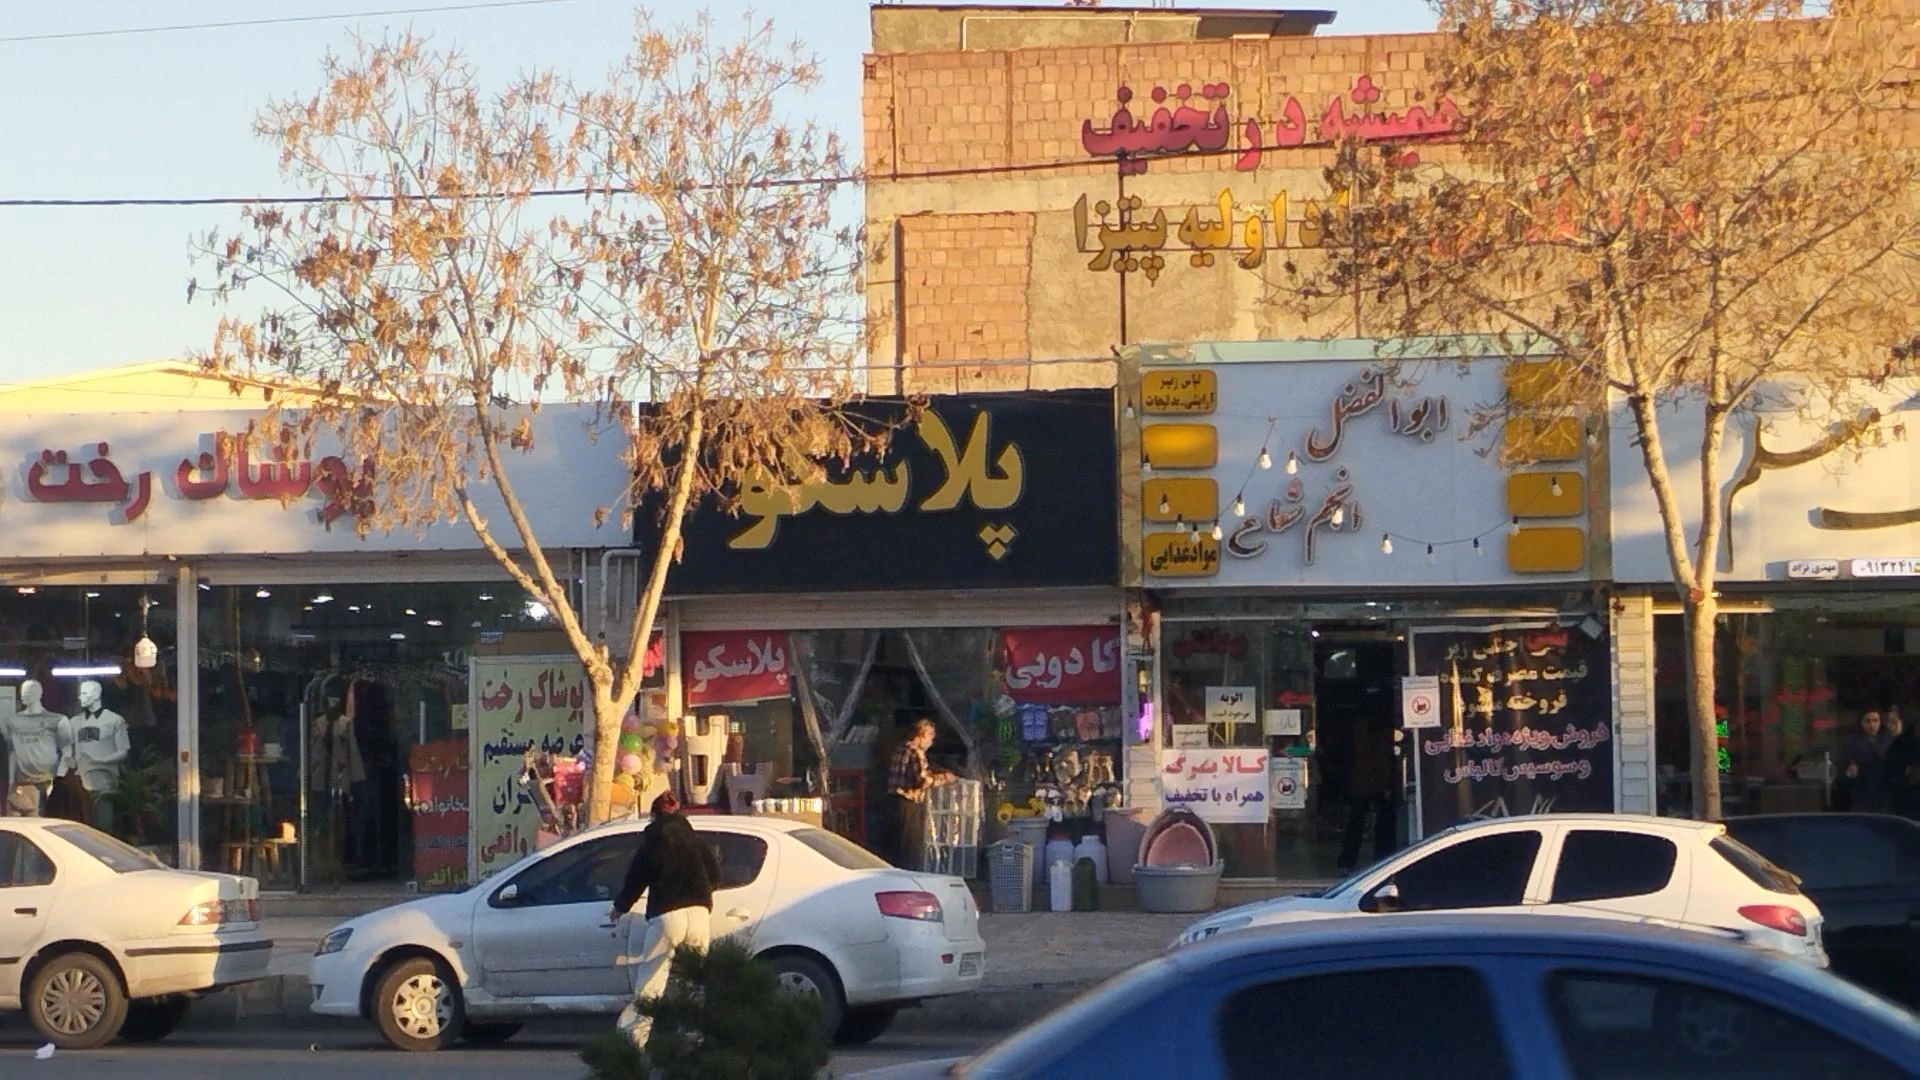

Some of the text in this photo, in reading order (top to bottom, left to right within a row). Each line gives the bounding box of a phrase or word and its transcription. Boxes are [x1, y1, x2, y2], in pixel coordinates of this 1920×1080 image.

[1082, 82, 1229, 174] تخفیف
[1235, 96, 1306, 171] در
[1321, 74, 1467, 168] همیشه
[1073, 192, 1167, 286] پیتزا
[1179, 187, 1288, 270] اولیه
[1305, 368, 1450, 462] ابوالفضل
[28, 441, 151, 523] رخت
[727, 408, 1025, 560] پلاسکو
[479, 668, 585, 724] پوشاک رخت
[691, 637, 788, 692] پلاسکو
[1542, 661, 1589, 684] قیمت
[483, 728, 535, 768] مستقیم
[1165, 786, 1265, 808] همراه با تخفیف
